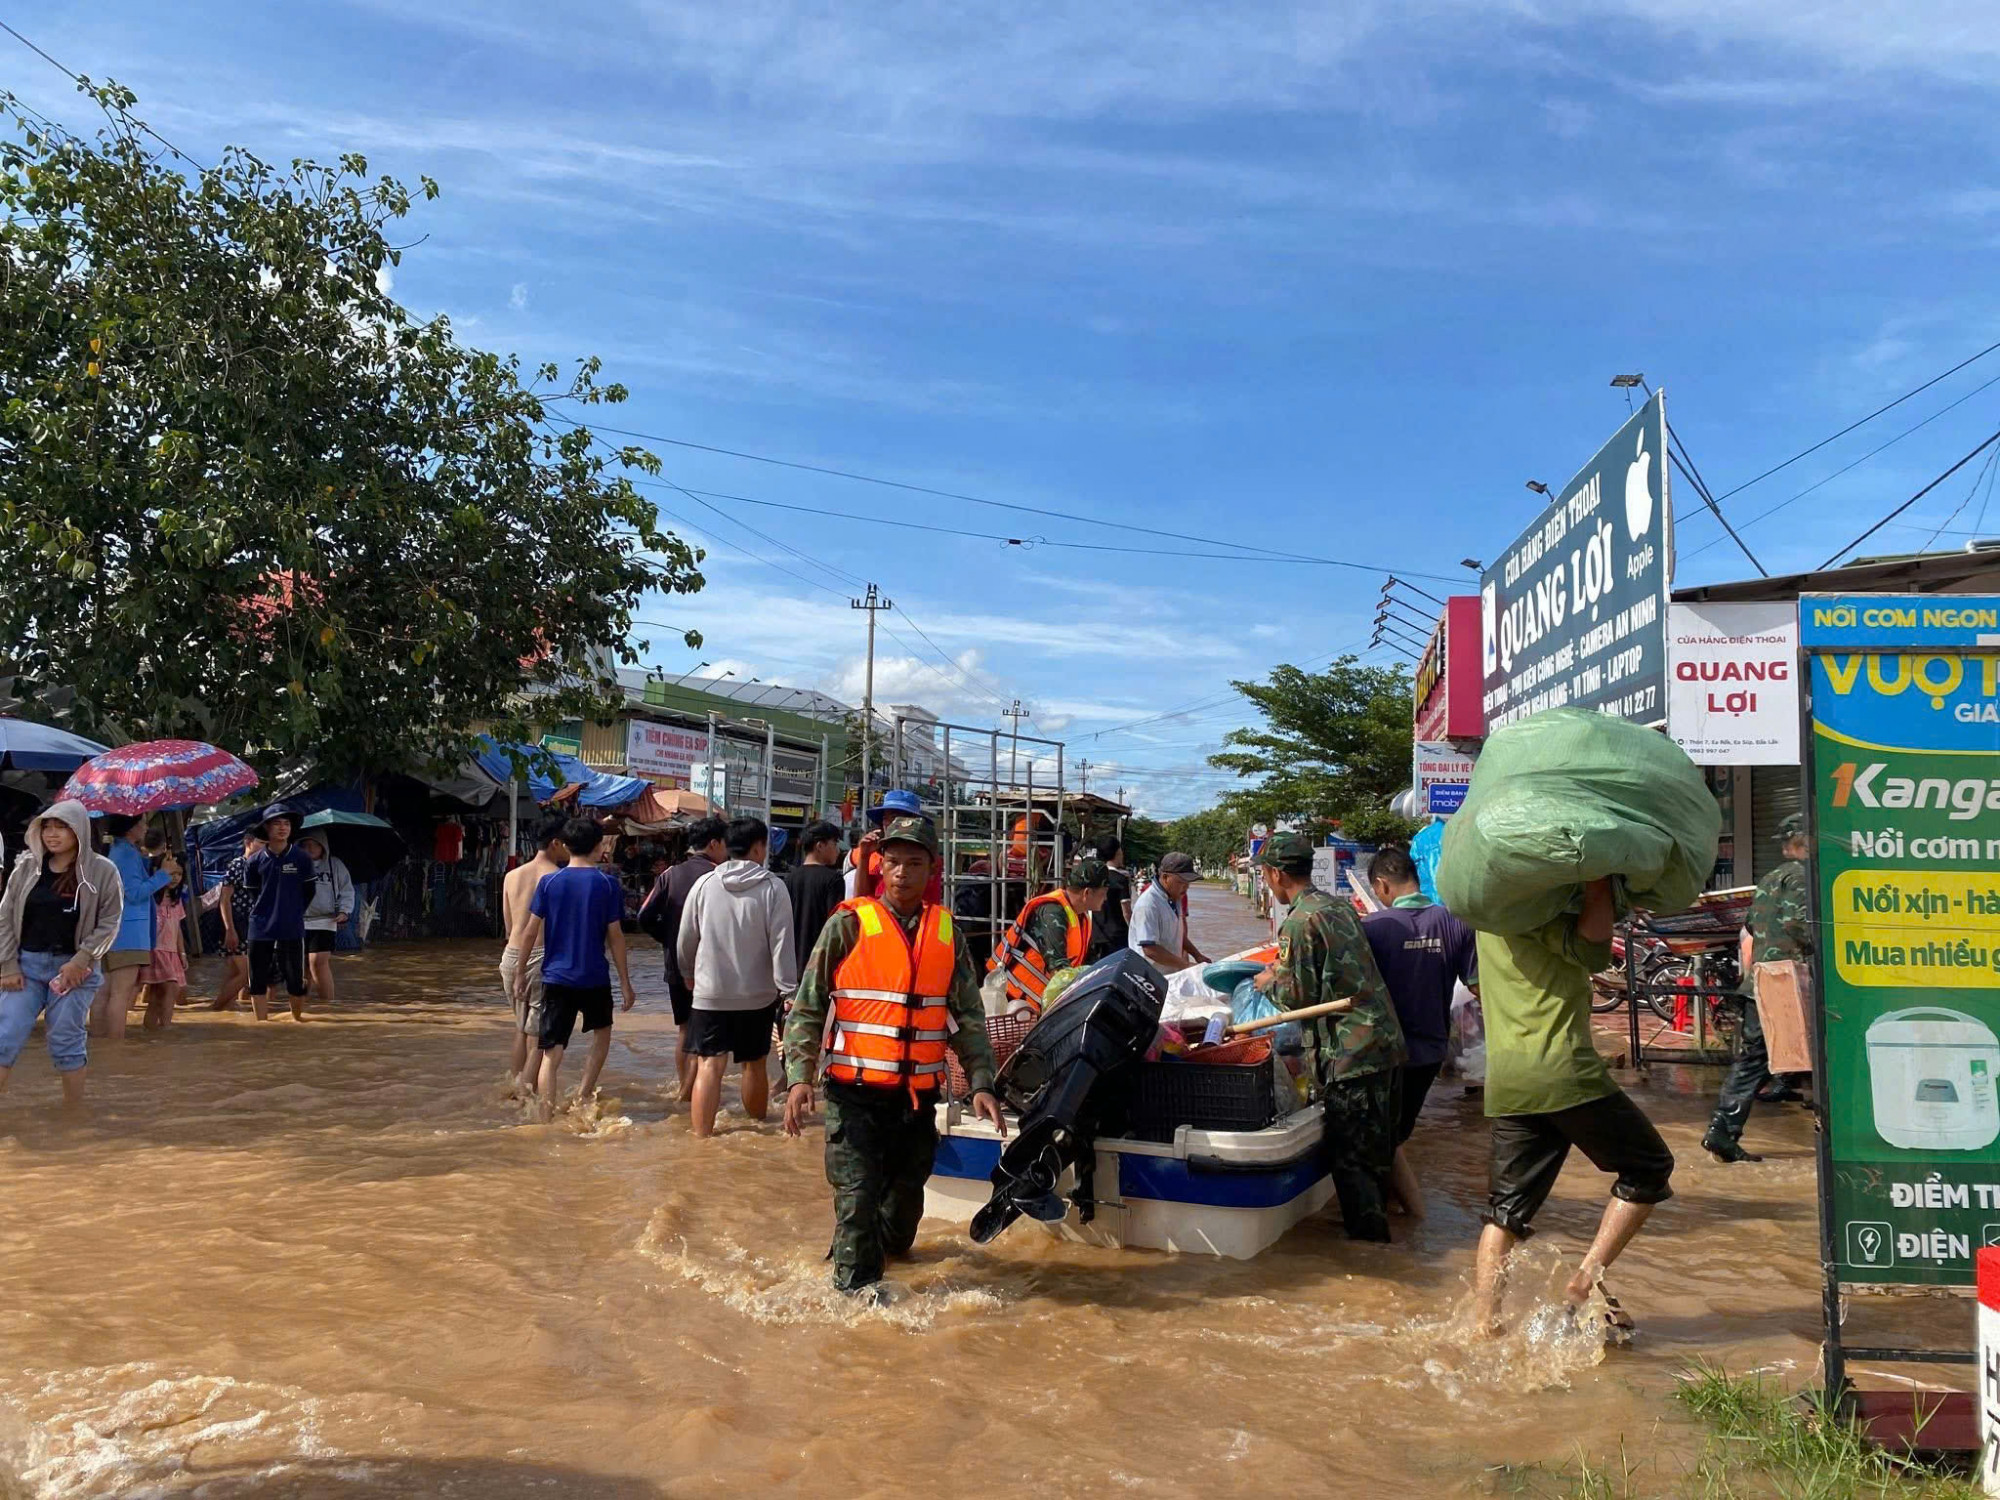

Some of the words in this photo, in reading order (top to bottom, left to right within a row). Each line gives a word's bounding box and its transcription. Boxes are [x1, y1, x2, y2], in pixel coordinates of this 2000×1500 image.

[1568, 472, 1600, 529] THOẠI
[1626, 544, 1654, 581] Apple
[1501, 563, 1567, 673] QUANG
[1571, 517, 1614, 622] LỢI
[1580, 619, 1613, 661] CAMERA
[1615, 609, 1629, 641] AN
[1631, 593, 1656, 631] NINH
[1923, 608, 1998, 629] NGON
[1607, 645, 1643, 685] LAPTOP
[1676, 661, 1788, 681] QUANG
[1635, 689, 1645, 714] 22
[1645, 685, 1656, 710] 77
[1708, 689, 1757, 717] LỢI
[1851, 827, 1904, 859] Nồi
[1910, 835, 1980, 860] cơm
[1852, 884, 1900, 914] Nồi
[1904, 888, 1949, 921] xịn
[1845, 940, 1906, 966] Mua
[1911, 938, 1988, 968] nhiều
[1132, 974, 1156, 992] 40
[1890, 1171, 1970, 1209] ĐIỂM
[1897, 1227, 1971, 1266] ĐIỆN
